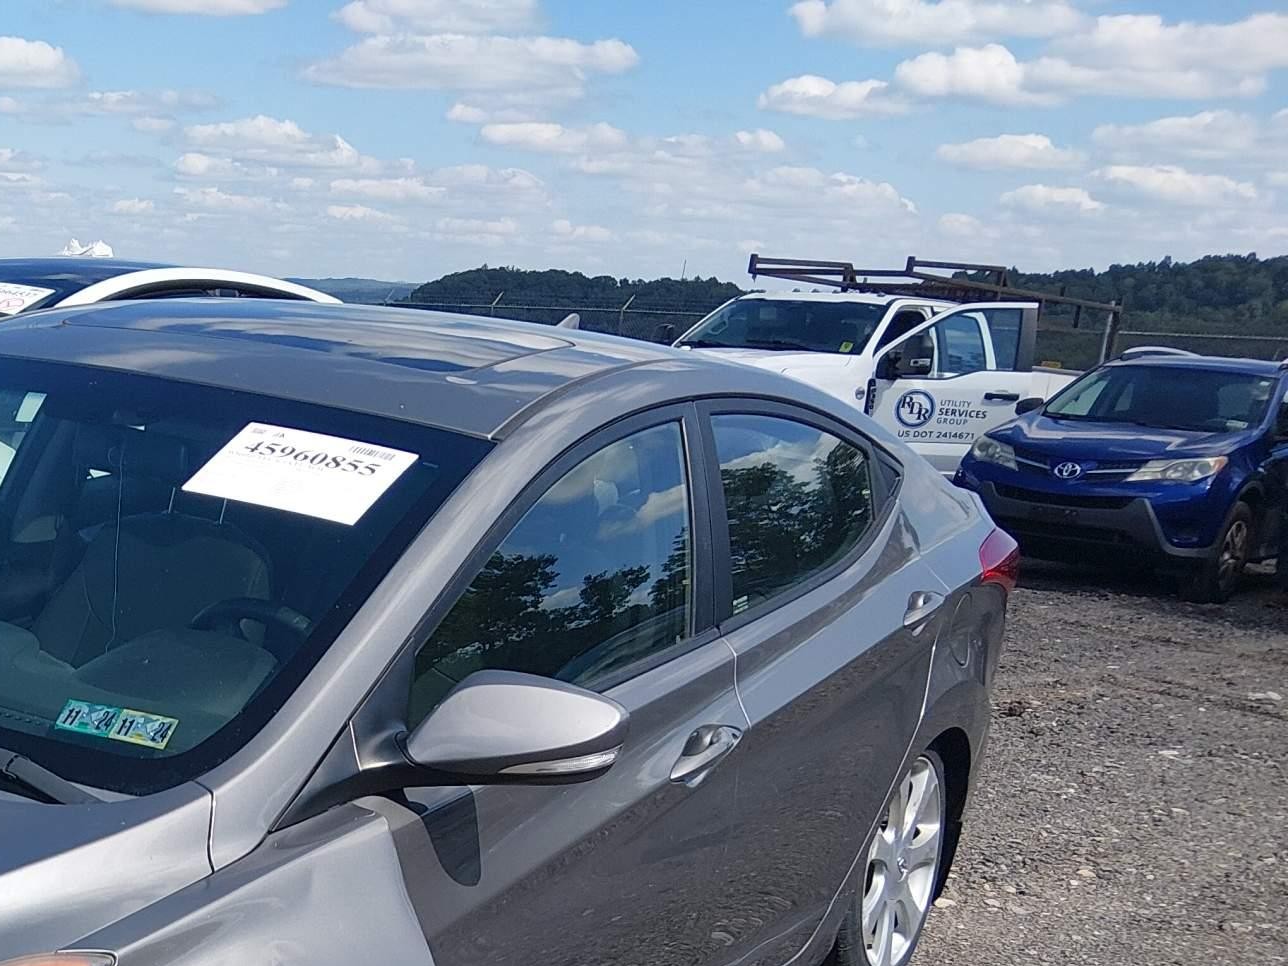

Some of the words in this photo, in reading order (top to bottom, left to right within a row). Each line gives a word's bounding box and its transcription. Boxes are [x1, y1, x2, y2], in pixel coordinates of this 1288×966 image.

[900, 396, 929, 421] RDR
[938, 408, 988, 419] SERVICES
[940, 399, 972, 408] UTILITY
[897, 430, 910, 438] US
[913, 430, 934, 438] DOT
[936, 431, 975, 440] 2414671
[244, 440, 382, 477] 45960855
[96, 710, 117, 731] 24
[151, 722, 172, 743] 24
